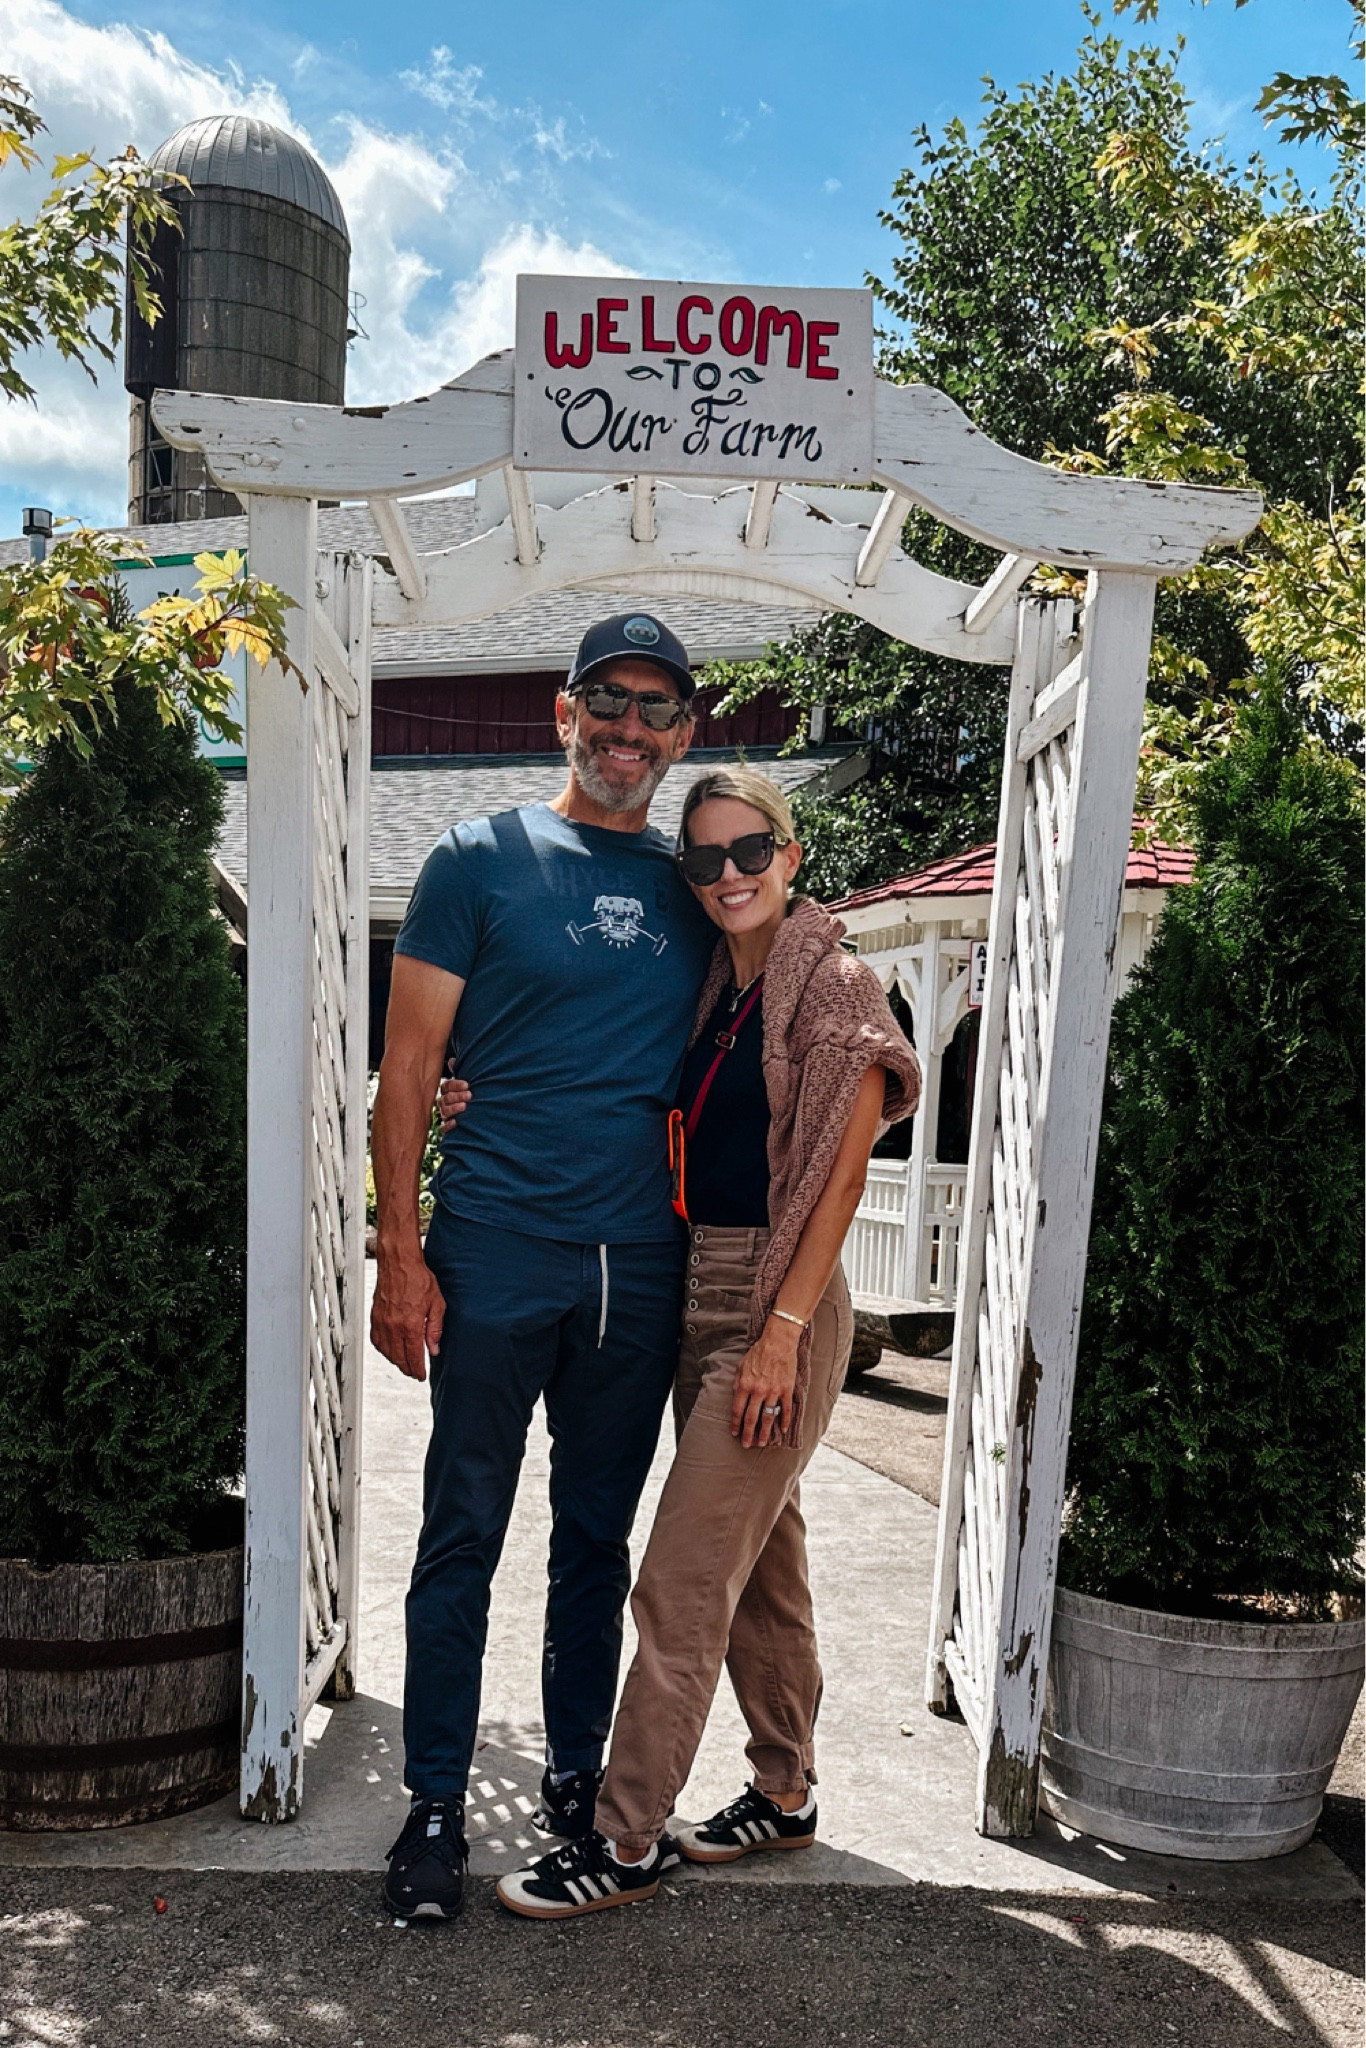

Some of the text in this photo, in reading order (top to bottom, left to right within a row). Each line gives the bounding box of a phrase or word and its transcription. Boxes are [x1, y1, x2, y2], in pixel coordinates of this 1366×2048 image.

[544, 295, 840, 380] WELCOME
[663, 357, 722, 392] TO
[546, 386, 822, 462] Our Farm
